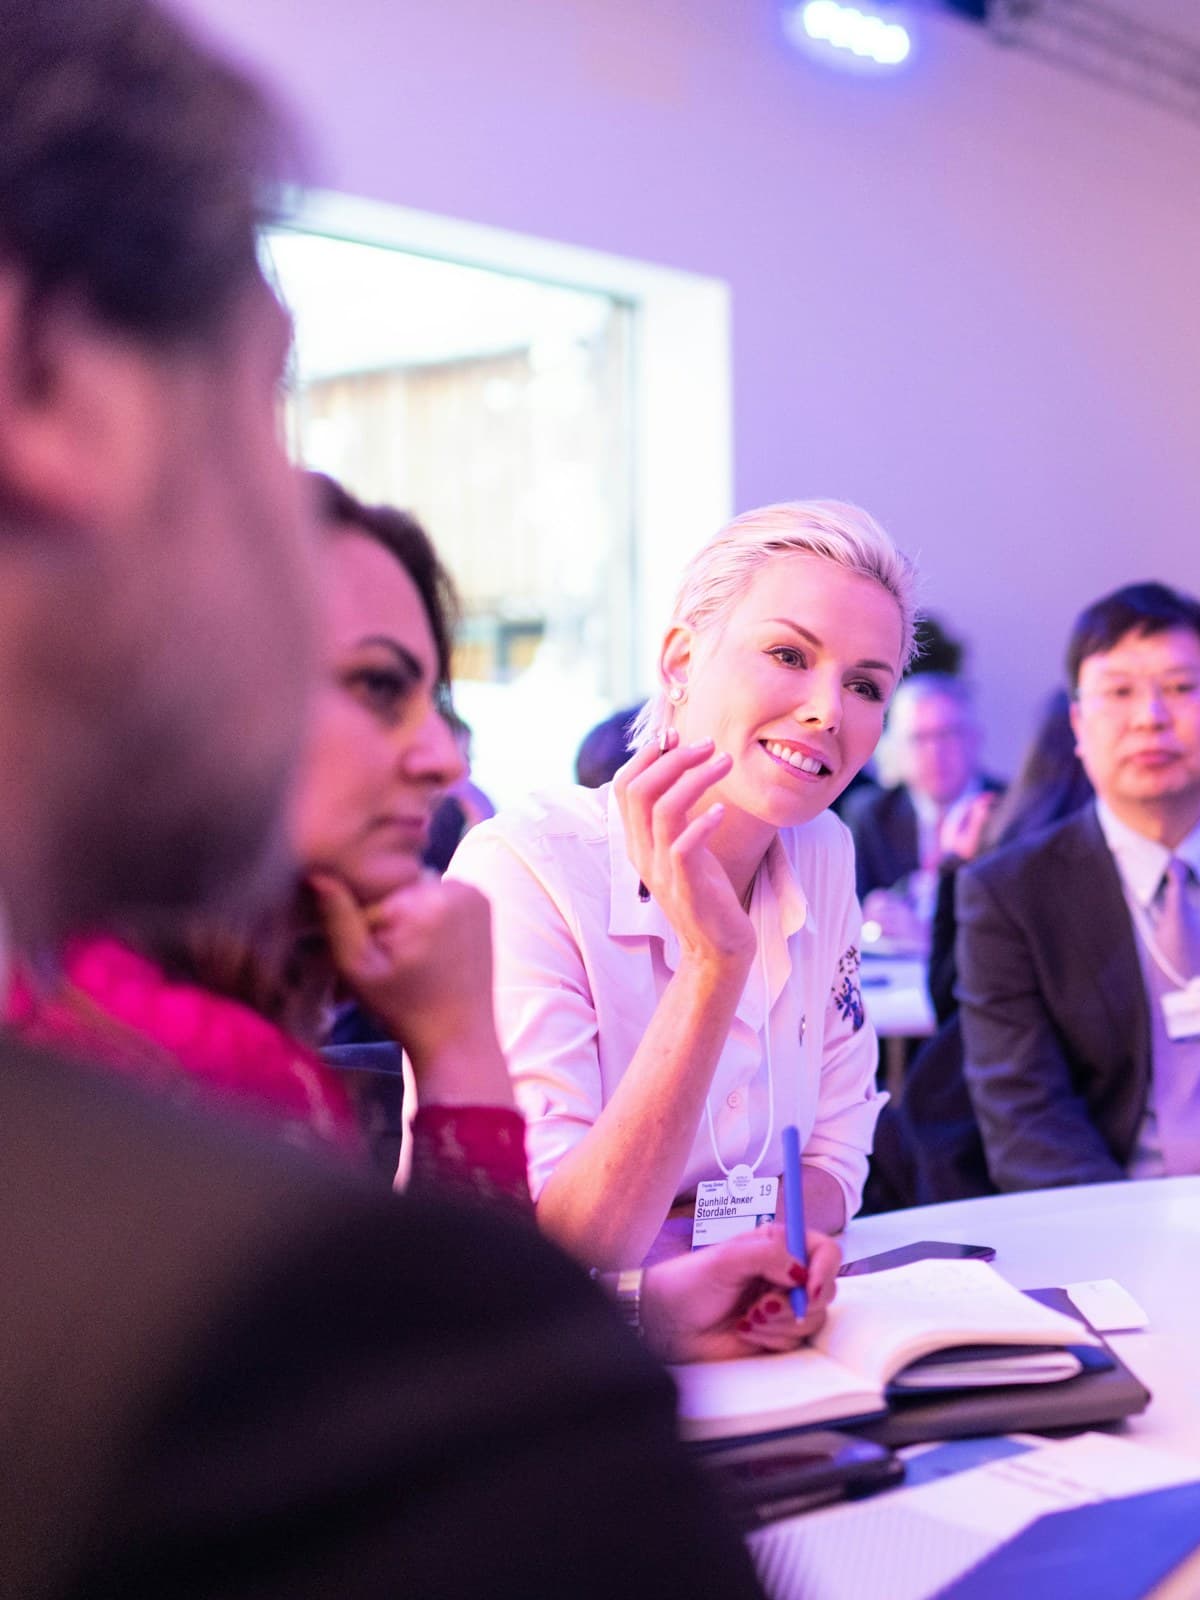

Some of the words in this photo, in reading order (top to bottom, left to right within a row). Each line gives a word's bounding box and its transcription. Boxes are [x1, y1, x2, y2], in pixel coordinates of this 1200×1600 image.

[760, 1184, 772, 1197] 19
[698, 1196, 729, 1208] Gunhild
[697, 1207, 737, 1218] Stordalen
